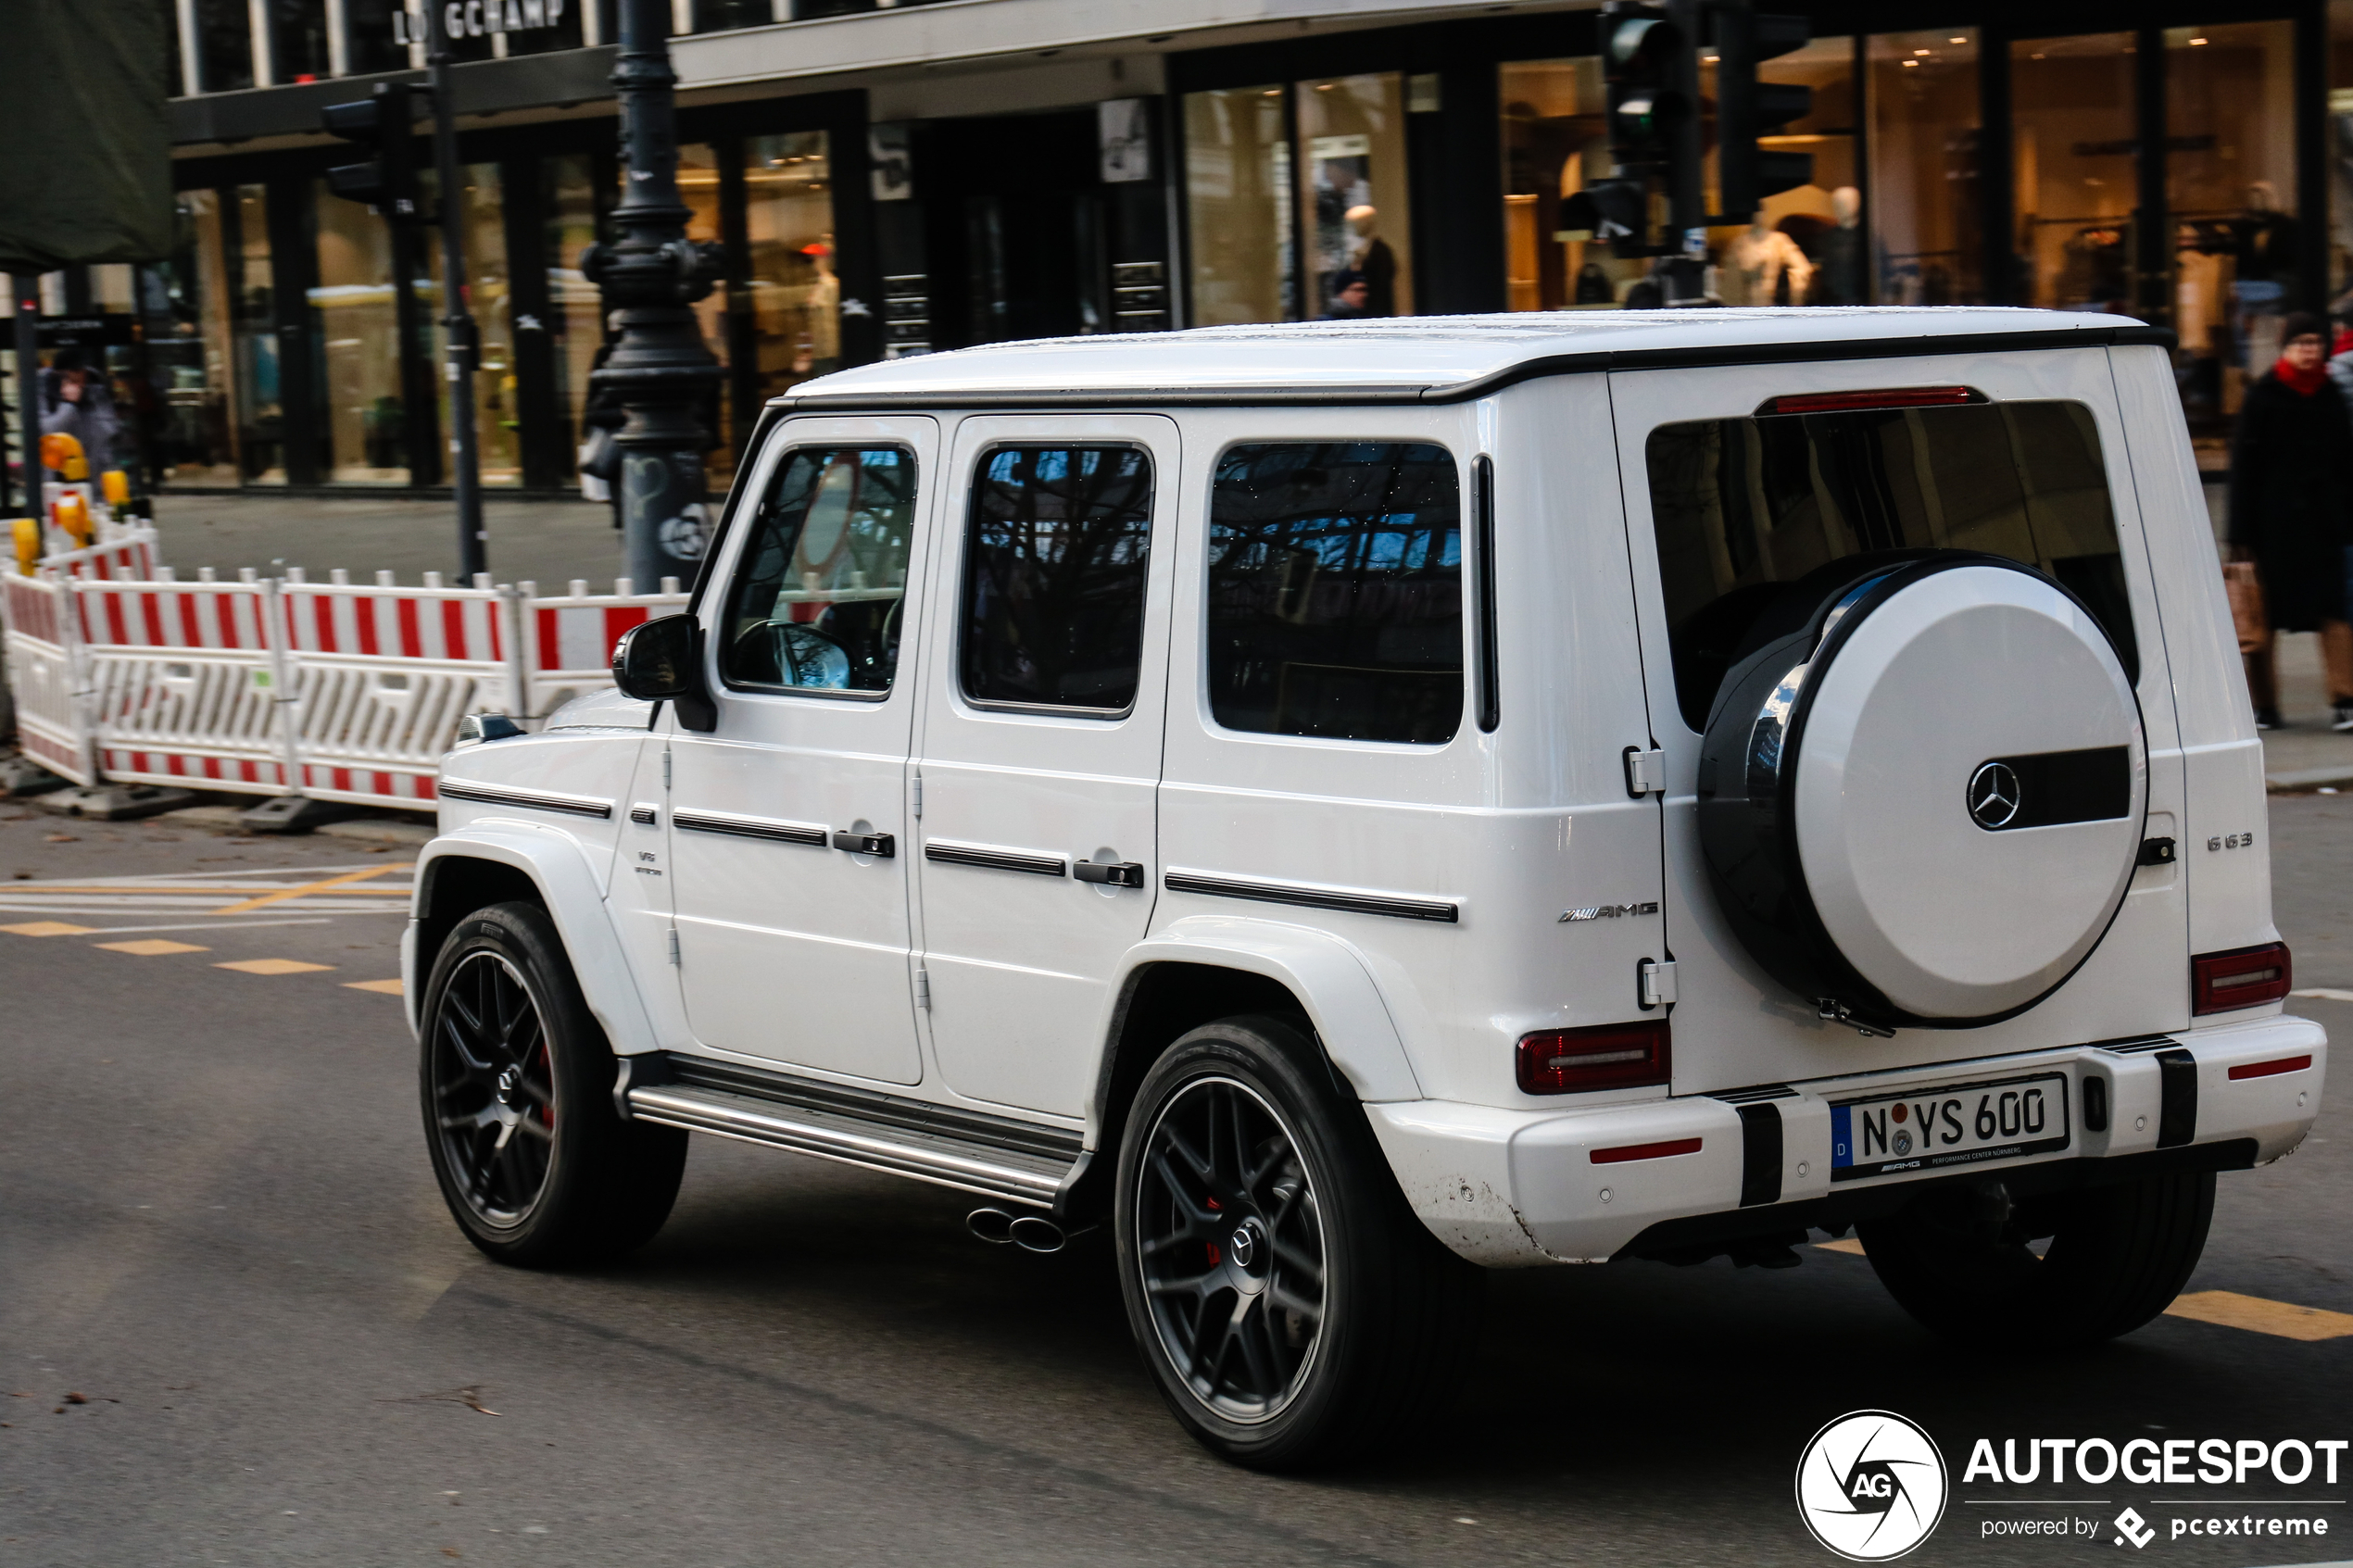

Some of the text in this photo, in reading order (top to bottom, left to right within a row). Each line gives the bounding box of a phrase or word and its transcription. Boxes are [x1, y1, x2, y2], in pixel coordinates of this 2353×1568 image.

[393, 0, 563, 44] LOGCHAMP
[2225, 833, 2252, 849] 63
[1593, 901, 1658, 919] AMG
[1863, 1088, 2045, 1157] N YS 600
[1837, 1143, 1846, 1156] D
[1893, 1147, 2021, 1170] AMG PERFORMANCE CENTER NÜRNBERG
